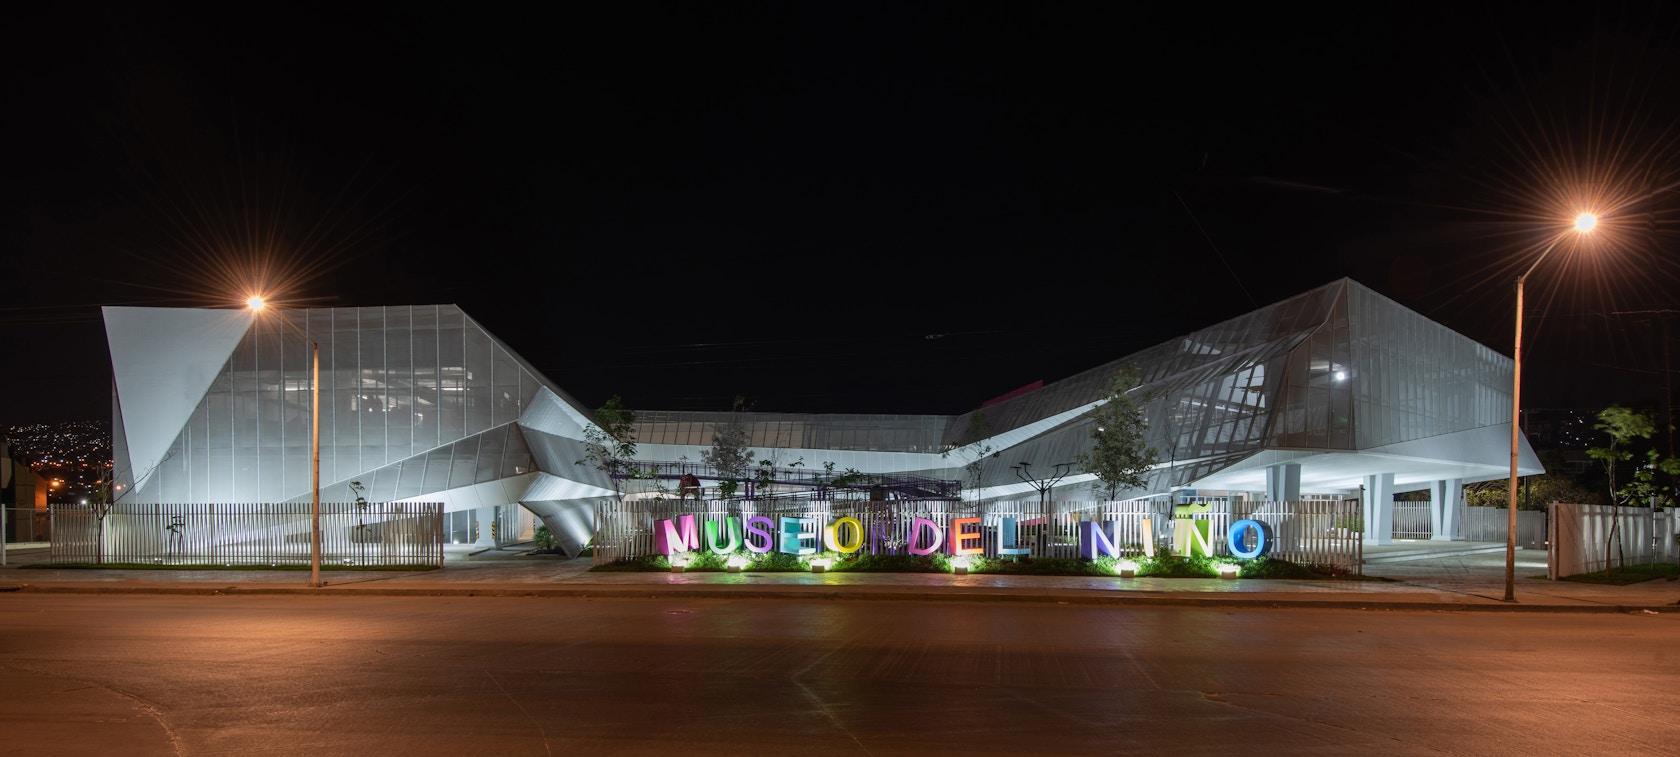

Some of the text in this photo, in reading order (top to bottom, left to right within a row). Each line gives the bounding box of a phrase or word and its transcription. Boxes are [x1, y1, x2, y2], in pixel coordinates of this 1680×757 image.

[654, 503, 1273, 560] MUSEO DEL NIÑO
